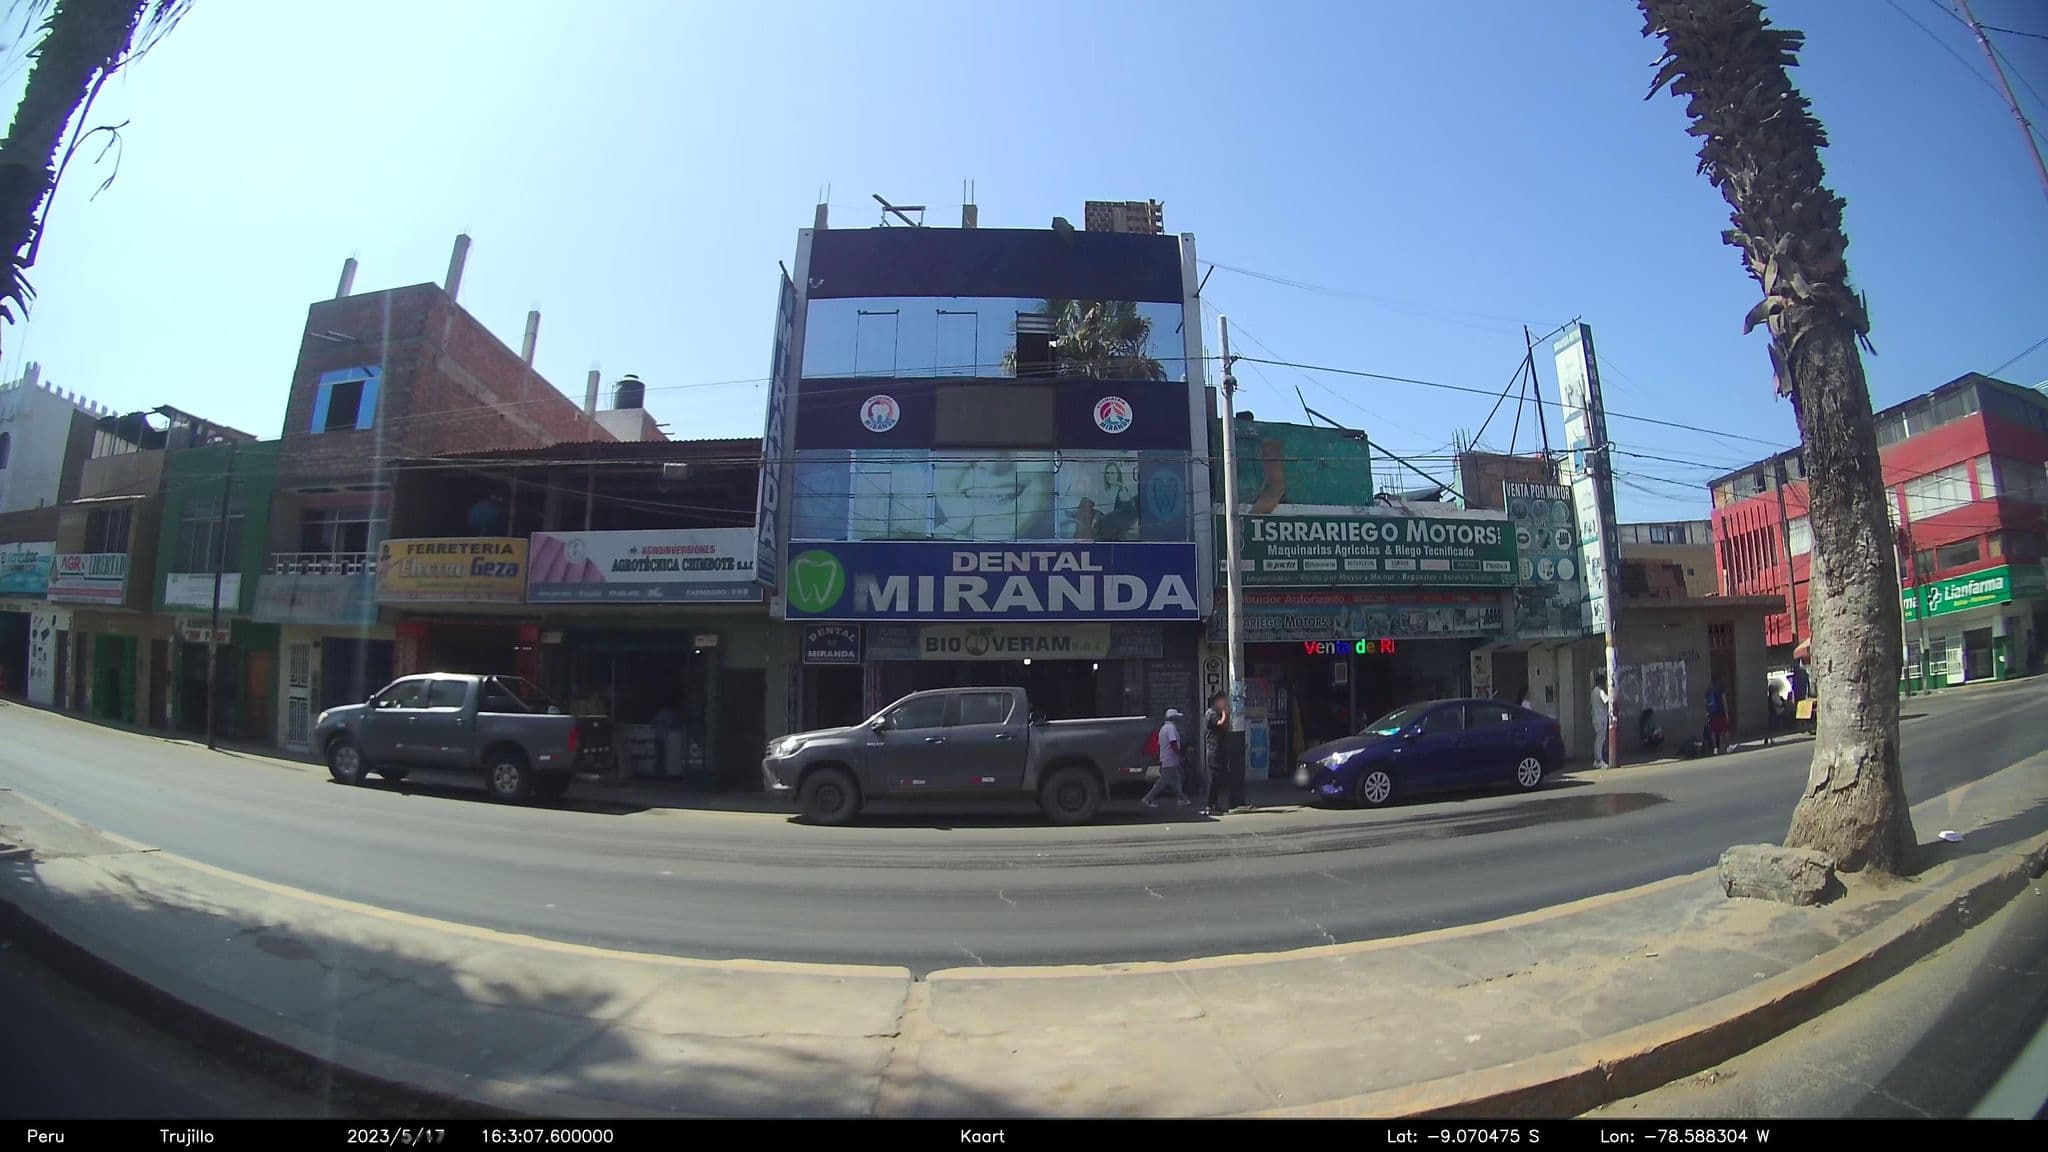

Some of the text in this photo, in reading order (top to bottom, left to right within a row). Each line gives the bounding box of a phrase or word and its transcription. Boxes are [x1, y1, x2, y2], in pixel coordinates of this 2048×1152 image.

[1099, 417, 1131, 432] MIRANDA
[1506, 483, 1571, 500] VENTA POR MAYOR
[1251, 519, 1399, 542] ISRRARIEGO
[1406, 519, 1497, 545] MOTORS
[407, 543, 513, 555] FERRETERIA
[641, 545, 716, 555] AGROINVERSIONES
[1267, 544, 1474, 558] Maquinarias Agricolas & Riego Tecnificado
[471, 557, 520, 577] Geza
[952, 551, 1102, 572] DENTAL
[855, 575, 1198, 612] MIRANDA
[1944, 577, 2004, 601] Lianfarma
[1284, 615, 1328, 630] MOTORS
[925, 637, 961, 652] BIO
[991, 637, 1073, 652] VERAM
[1356, 639, 1376, 654] de
[808, 650, 856, 658] MIRANDA
